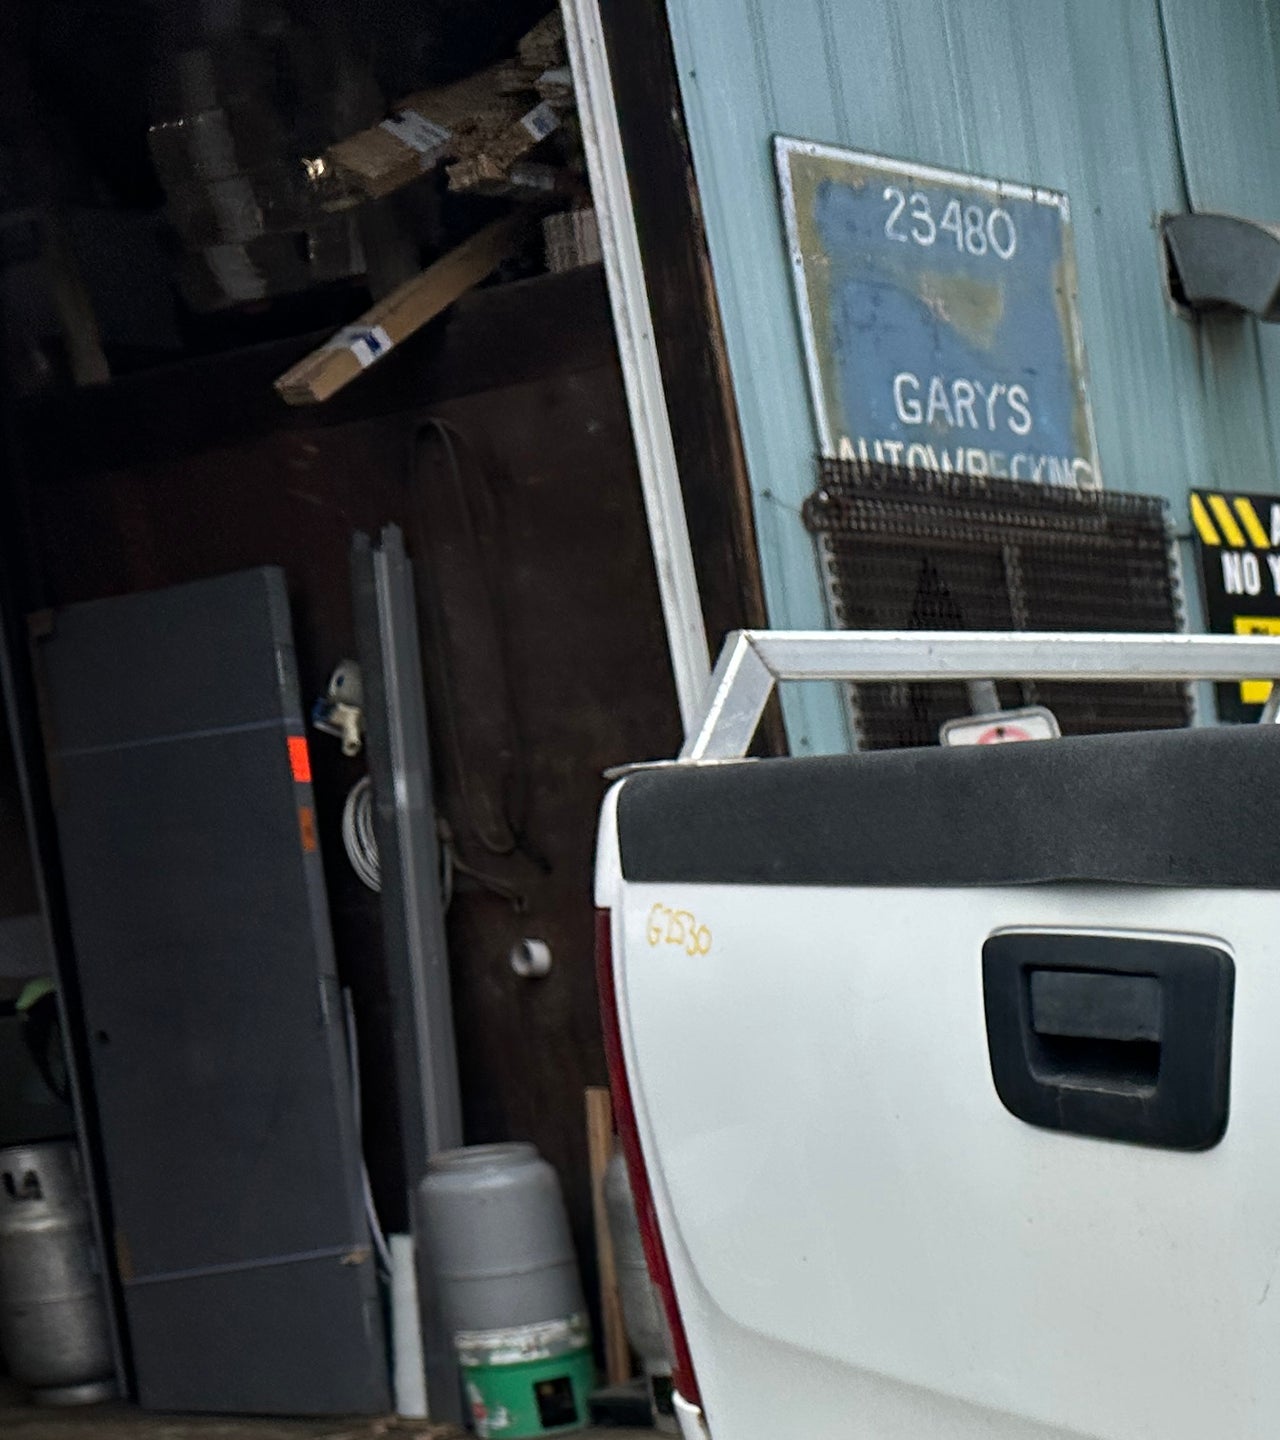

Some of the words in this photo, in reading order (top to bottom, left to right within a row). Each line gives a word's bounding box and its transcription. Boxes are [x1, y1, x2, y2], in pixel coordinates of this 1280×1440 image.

[882, 185, 1017, 260] 23480
[1221, 551, 1262, 596] NO
[646, 902, 713, 956] G2530
